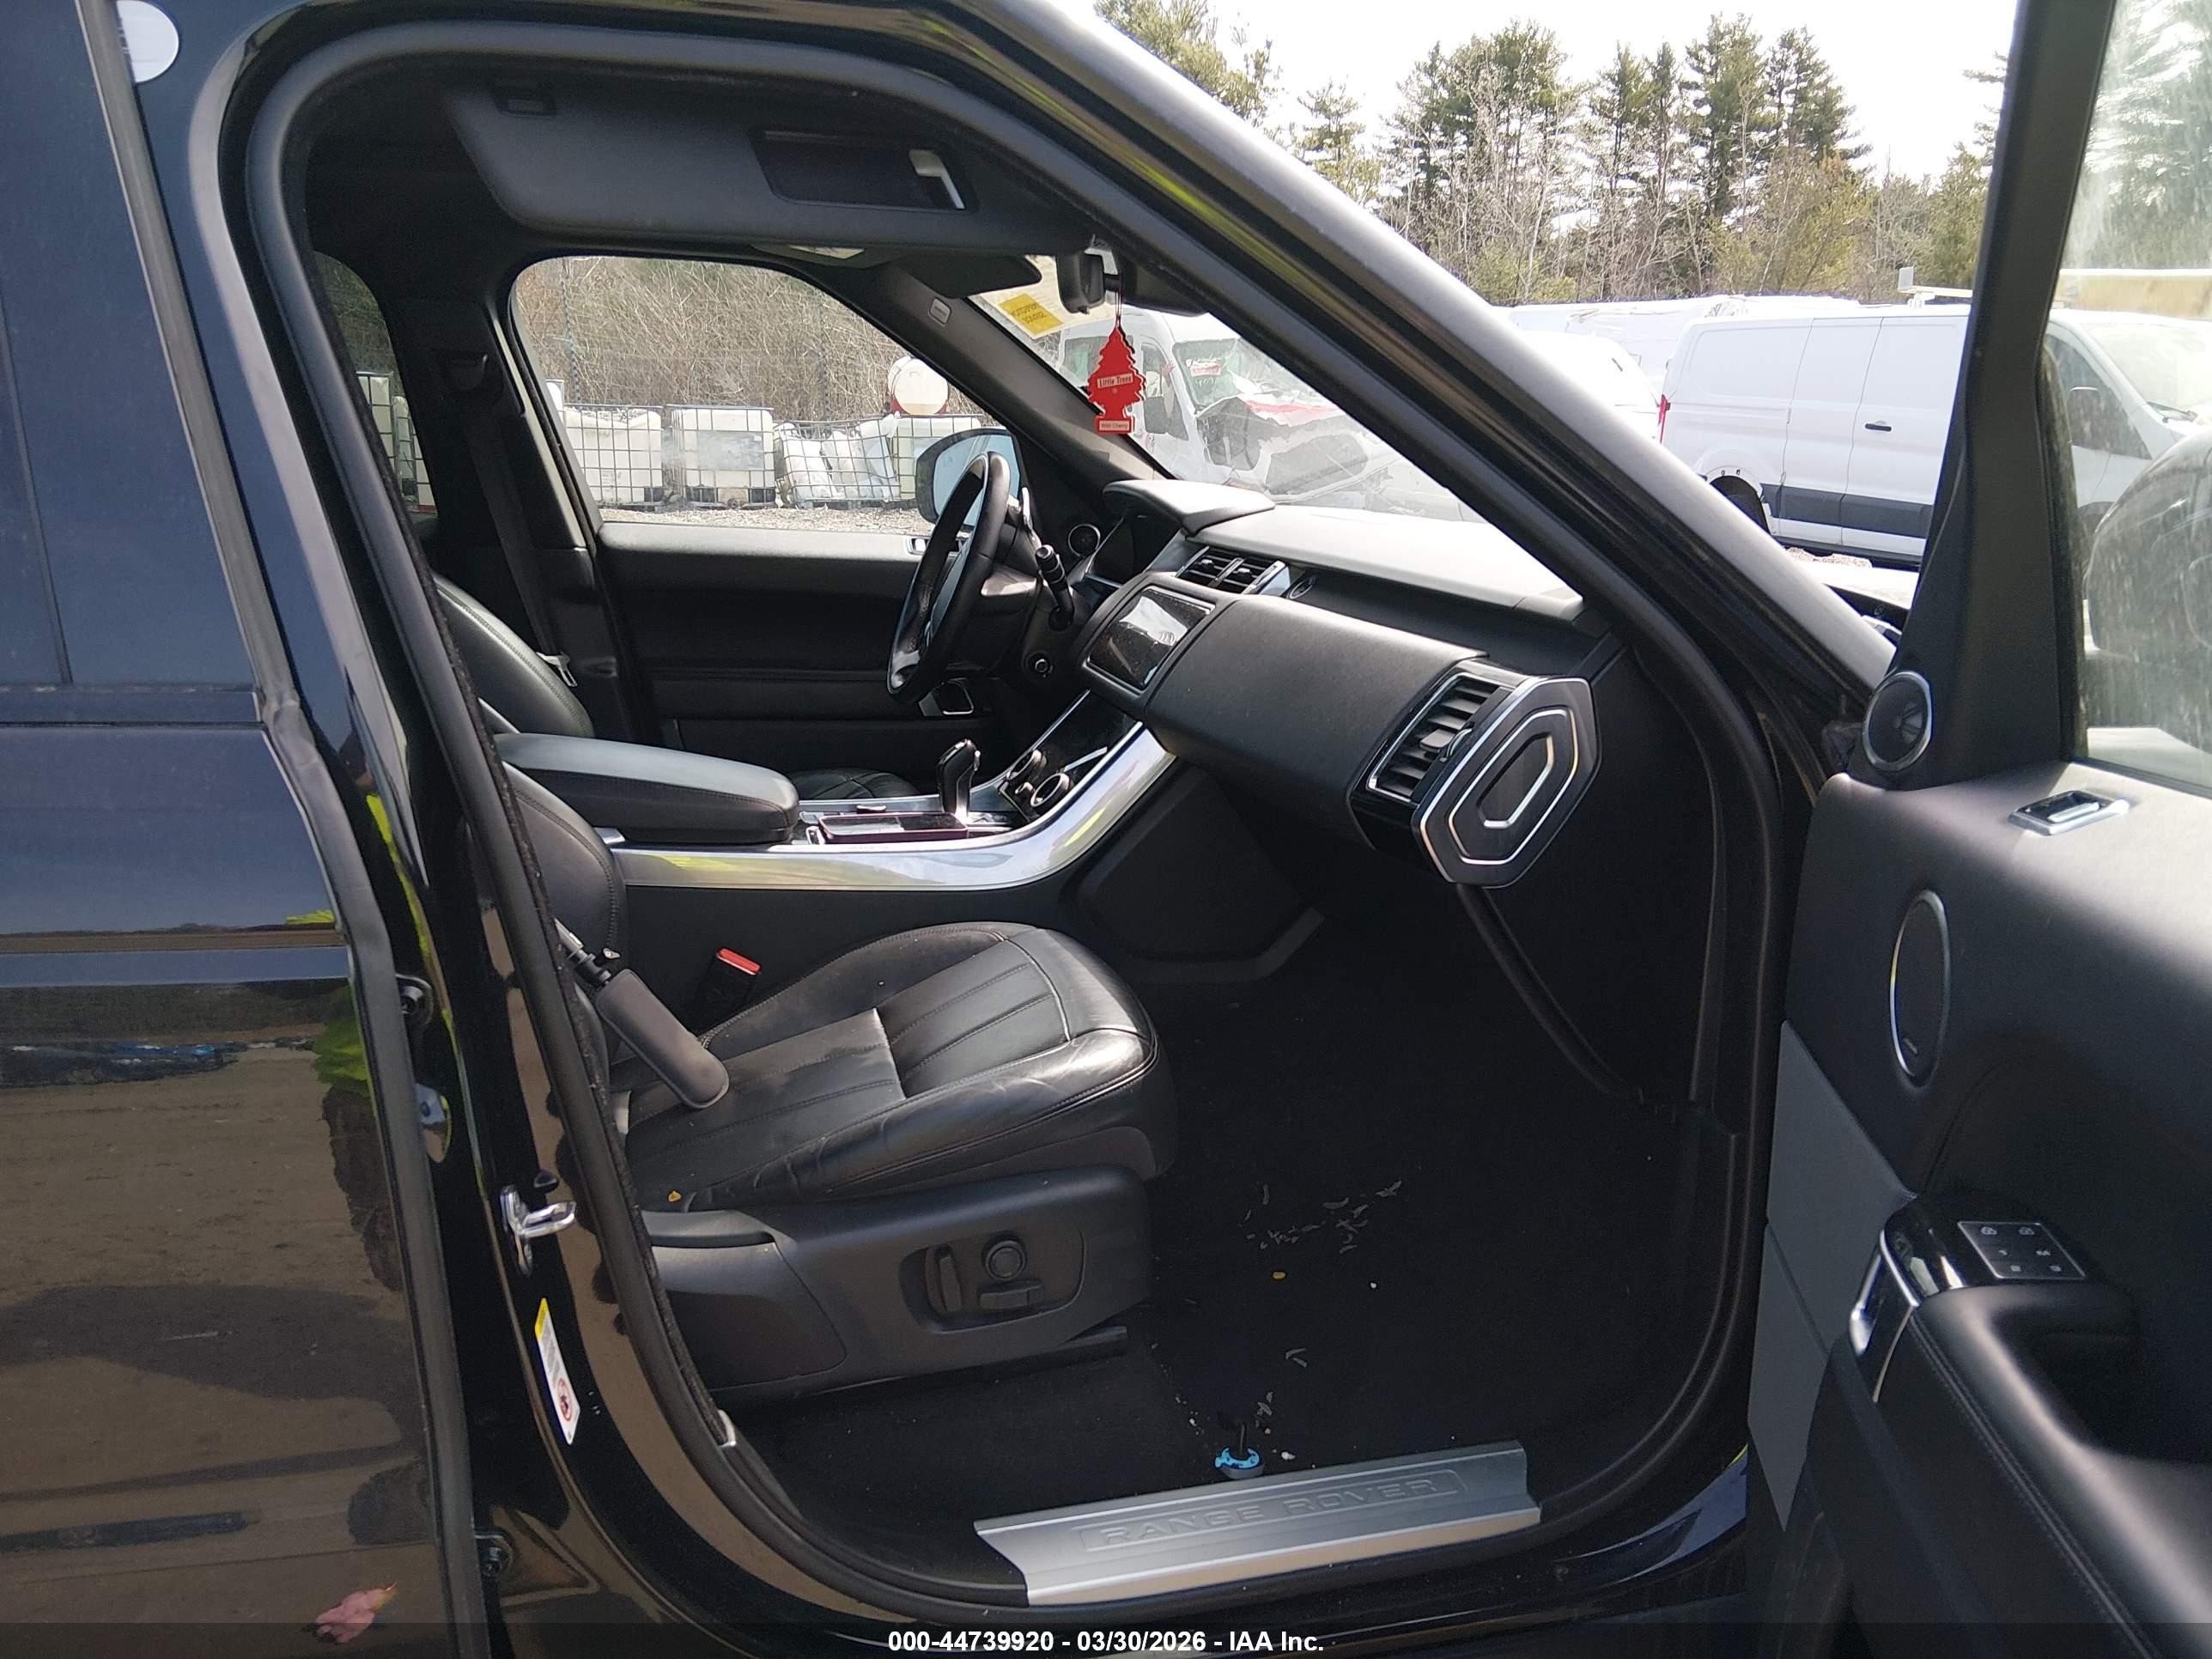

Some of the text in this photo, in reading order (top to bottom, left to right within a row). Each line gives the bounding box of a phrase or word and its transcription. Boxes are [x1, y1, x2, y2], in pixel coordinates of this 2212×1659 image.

[1099, 375, 1132, 387] Little Trees
[1100, 1478, 1437, 1545] RANGE ROVER
